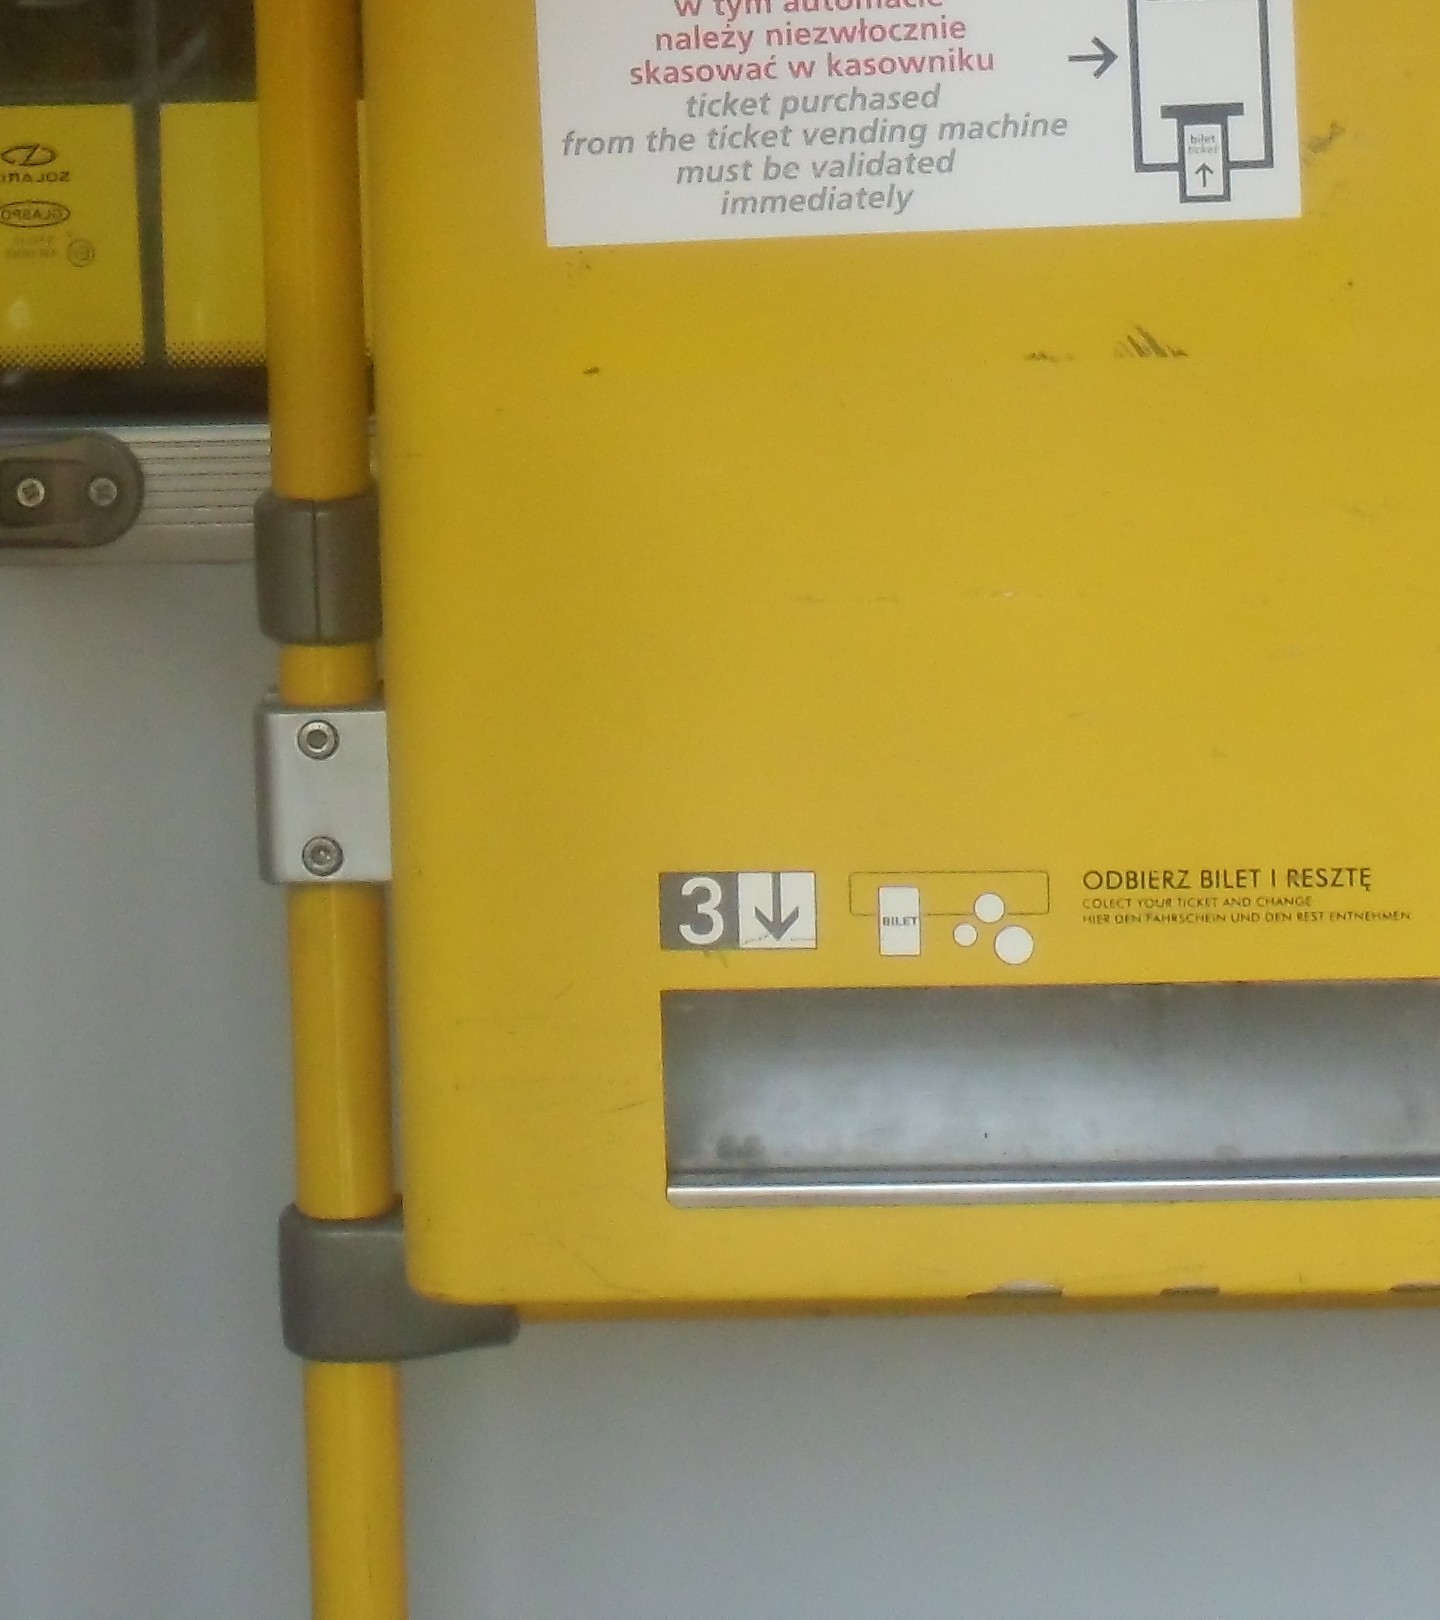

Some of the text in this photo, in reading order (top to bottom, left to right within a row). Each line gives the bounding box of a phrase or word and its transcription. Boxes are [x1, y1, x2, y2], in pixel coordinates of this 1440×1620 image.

[674, 0, 703, 18] w
[655, 16, 967, 55] należy niezwłocznie
[629, 47, 995, 85] skasować w kasowniku
[686, 83, 940, 118] ticket purchased
[560, 112, 1069, 158] from the ticket vending machine
[675, 148, 956, 185] must be validated
[719, 183, 914, 216] immediately
[1082, 867, 1372, 892] ODBIERZ BILET I RESZTĘ
[678, 876, 725, 946] 3
[1082, 895, 1314, 909] COLECT YOUR TICKET AND CHANGE
[1082, 910, 1411, 924] HIER DEN FAHRSCHEIN UND DEN REST ENTNEHMEN
[881, 915, 919, 926] BILET
